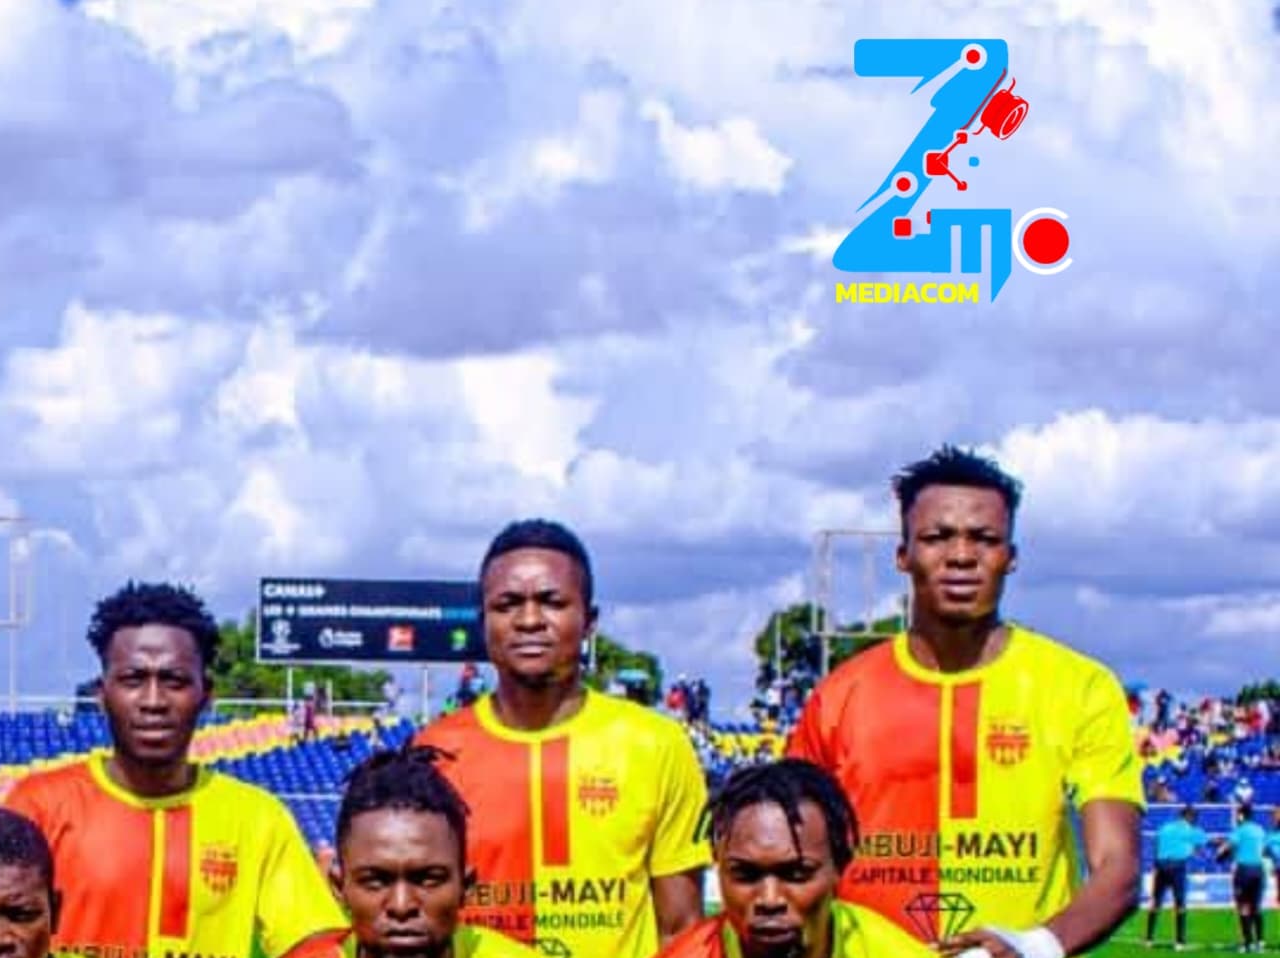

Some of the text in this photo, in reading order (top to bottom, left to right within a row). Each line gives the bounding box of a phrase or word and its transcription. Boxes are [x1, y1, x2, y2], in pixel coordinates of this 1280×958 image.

[851, 866, 1039, 884] CAPITALE MONDIALE
[534, 912, 625, 929] MONDIALE
